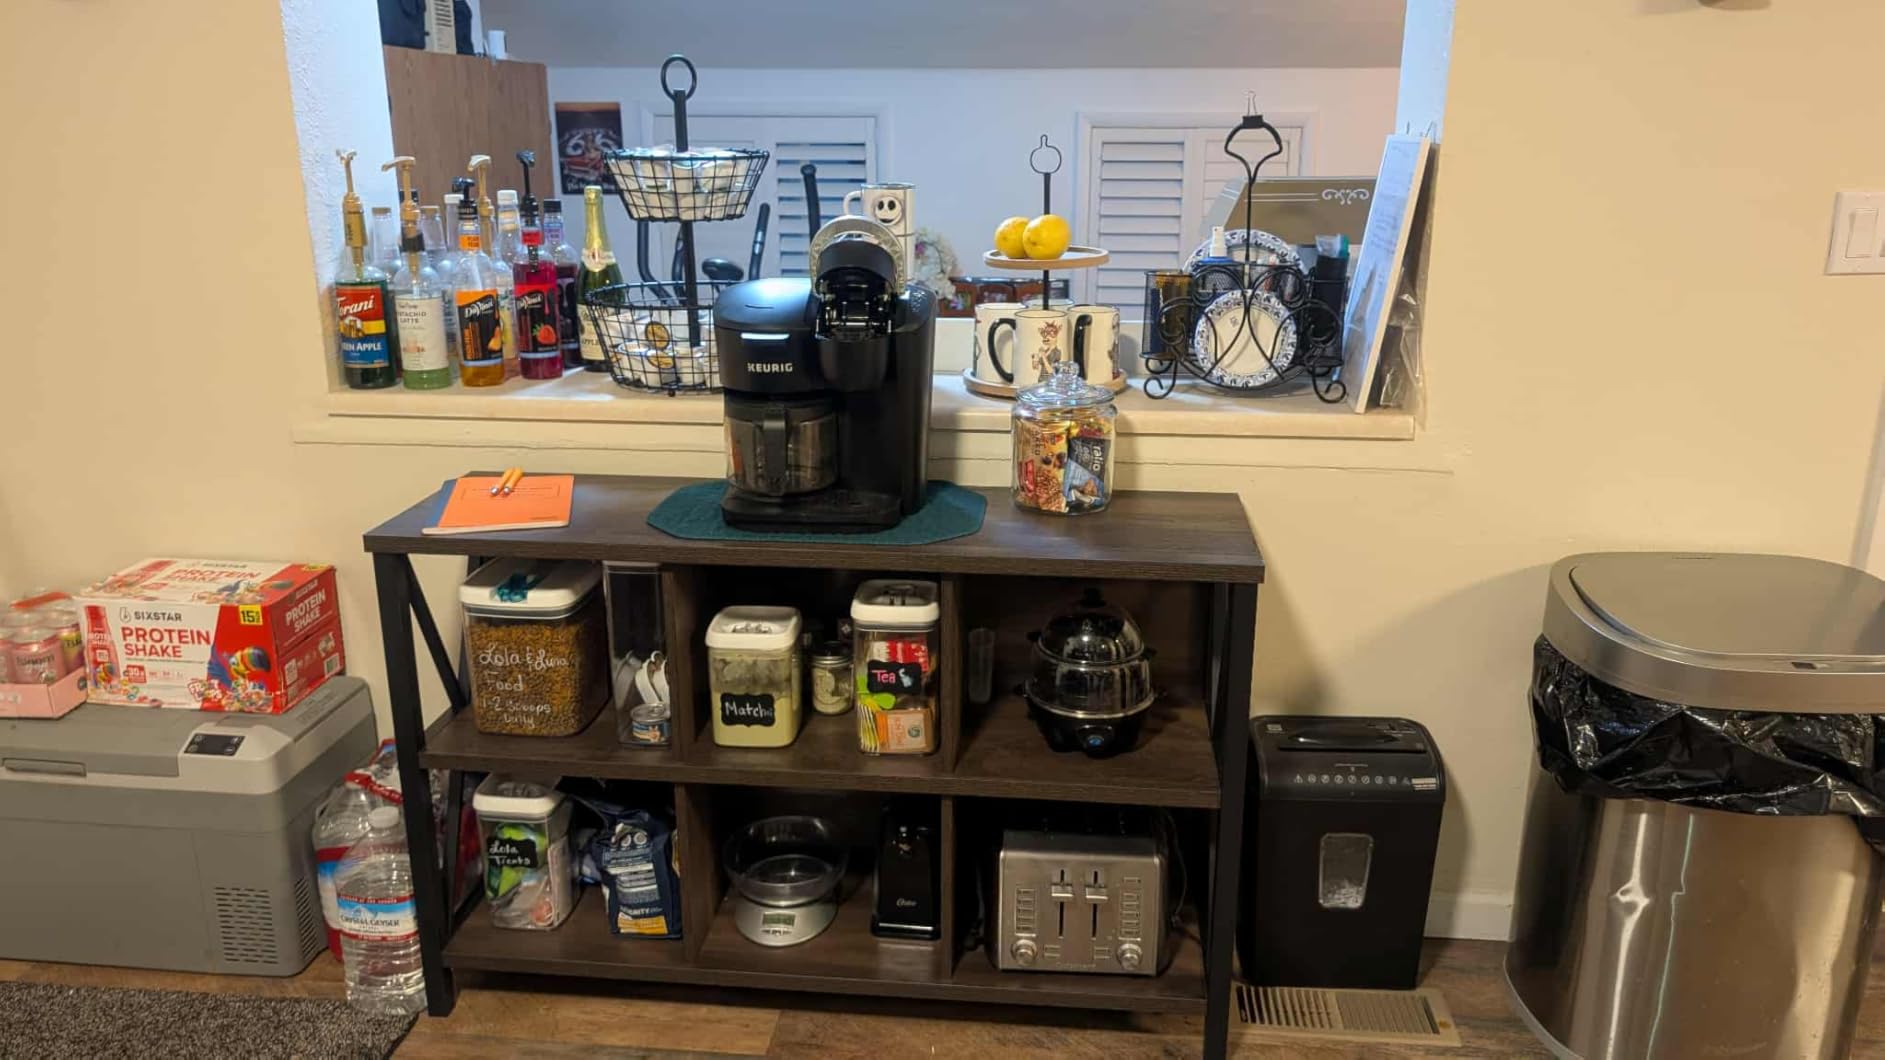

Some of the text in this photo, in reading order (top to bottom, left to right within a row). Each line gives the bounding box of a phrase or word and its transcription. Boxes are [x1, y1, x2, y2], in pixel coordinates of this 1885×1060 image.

[356, 342, 382, 352] APPLE
[746, 362, 794, 373] KEURIG
[1091, 445, 1104, 472] ratio
[285, 588, 327, 627] PROTEIN
[134, 611, 182, 622] SIXSTAR
[240, 610, 256, 624] 15
[294, 606, 321, 633] SHAKE
[121, 626, 212, 646] PROTEIN
[124, 643, 183, 658] SHAKE
[479, 642, 522, 667] Lola
[534, 649, 569, 671] Luna
[484, 670, 525, 692] Food
[871, 669, 897, 684] Tea
[489, 840, 519, 854] Lola
[488, 855, 531, 866] Treats
